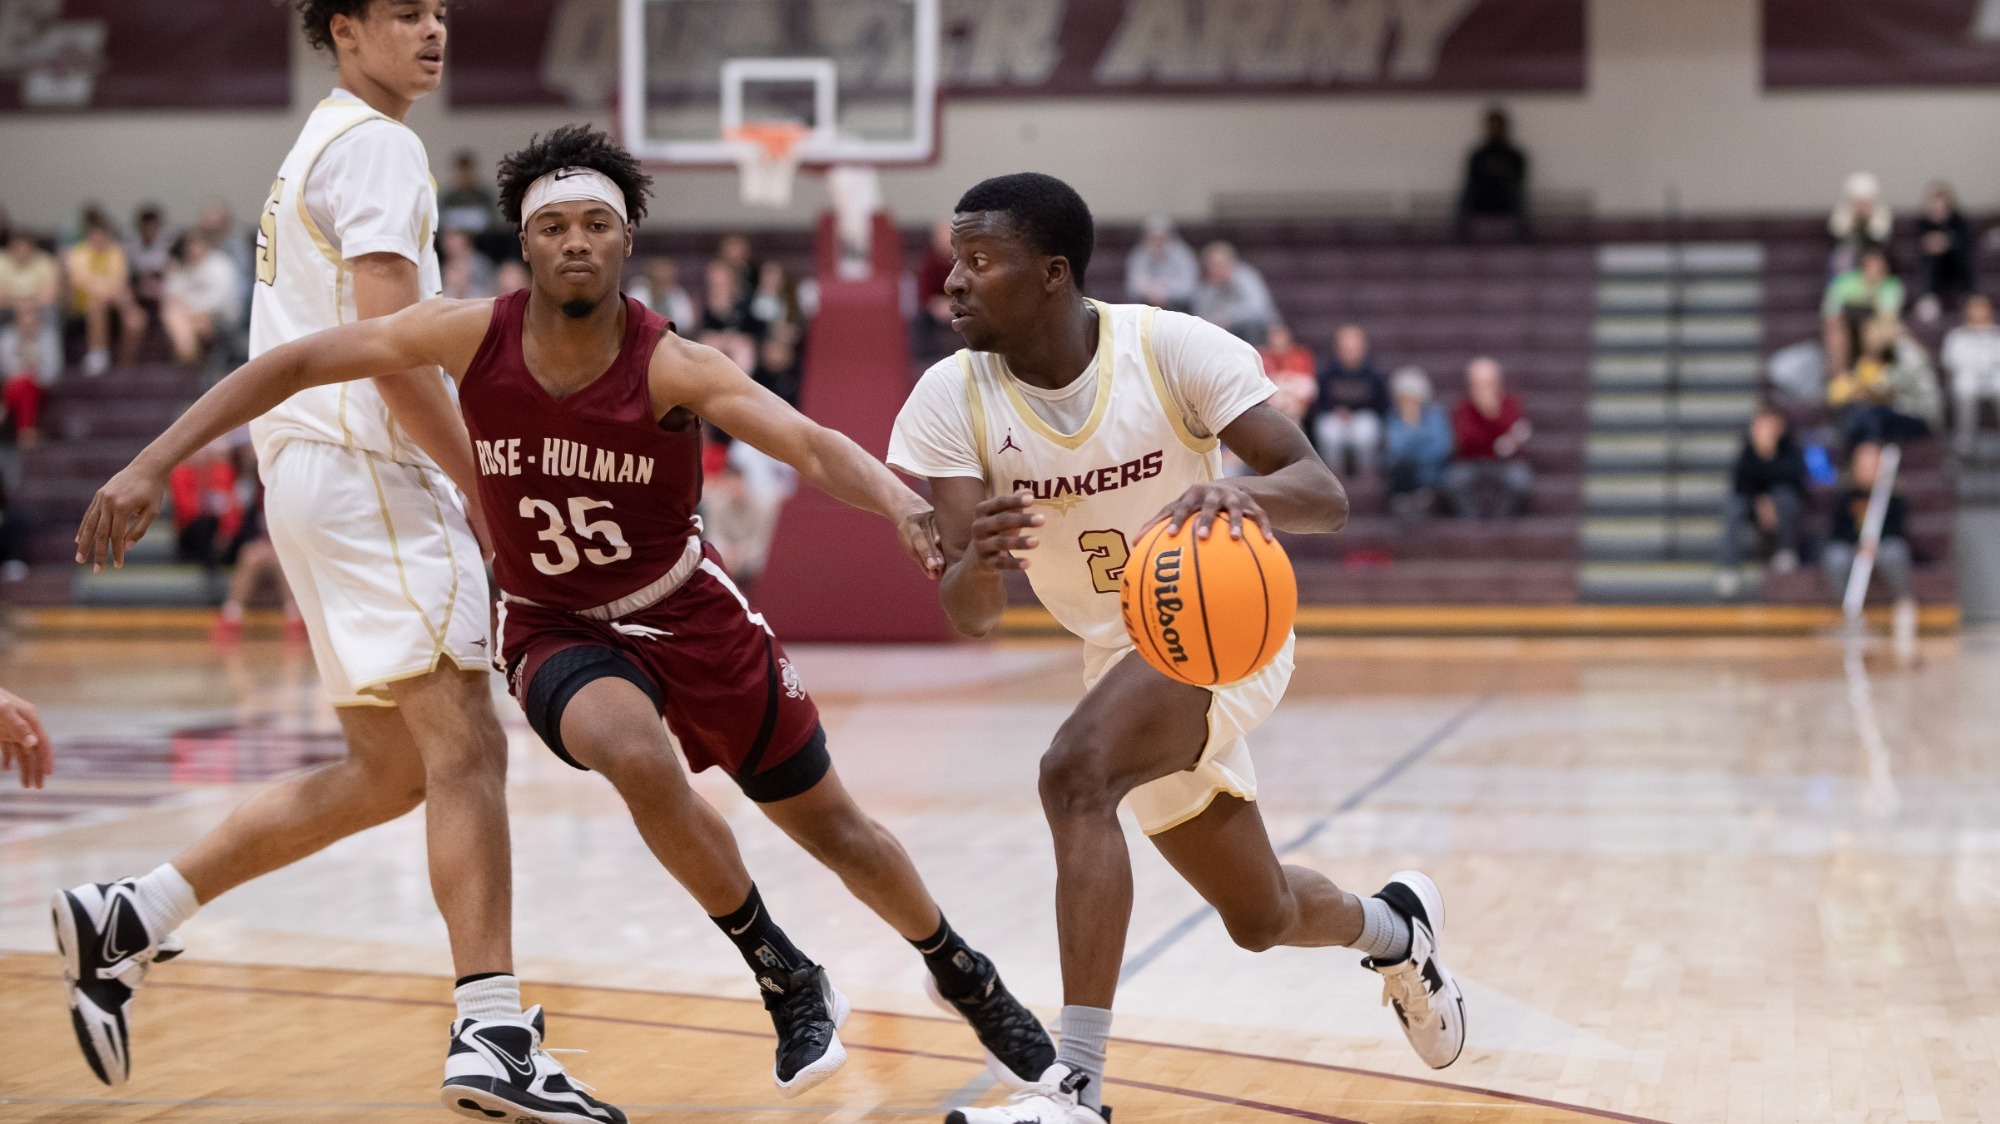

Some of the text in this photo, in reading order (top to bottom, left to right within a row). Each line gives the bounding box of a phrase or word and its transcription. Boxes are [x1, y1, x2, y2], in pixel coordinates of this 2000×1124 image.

[518, 496, 632, 576] 35
[1078, 528, 1131, 593] 2
[1154, 546, 1189, 664] Wilson
